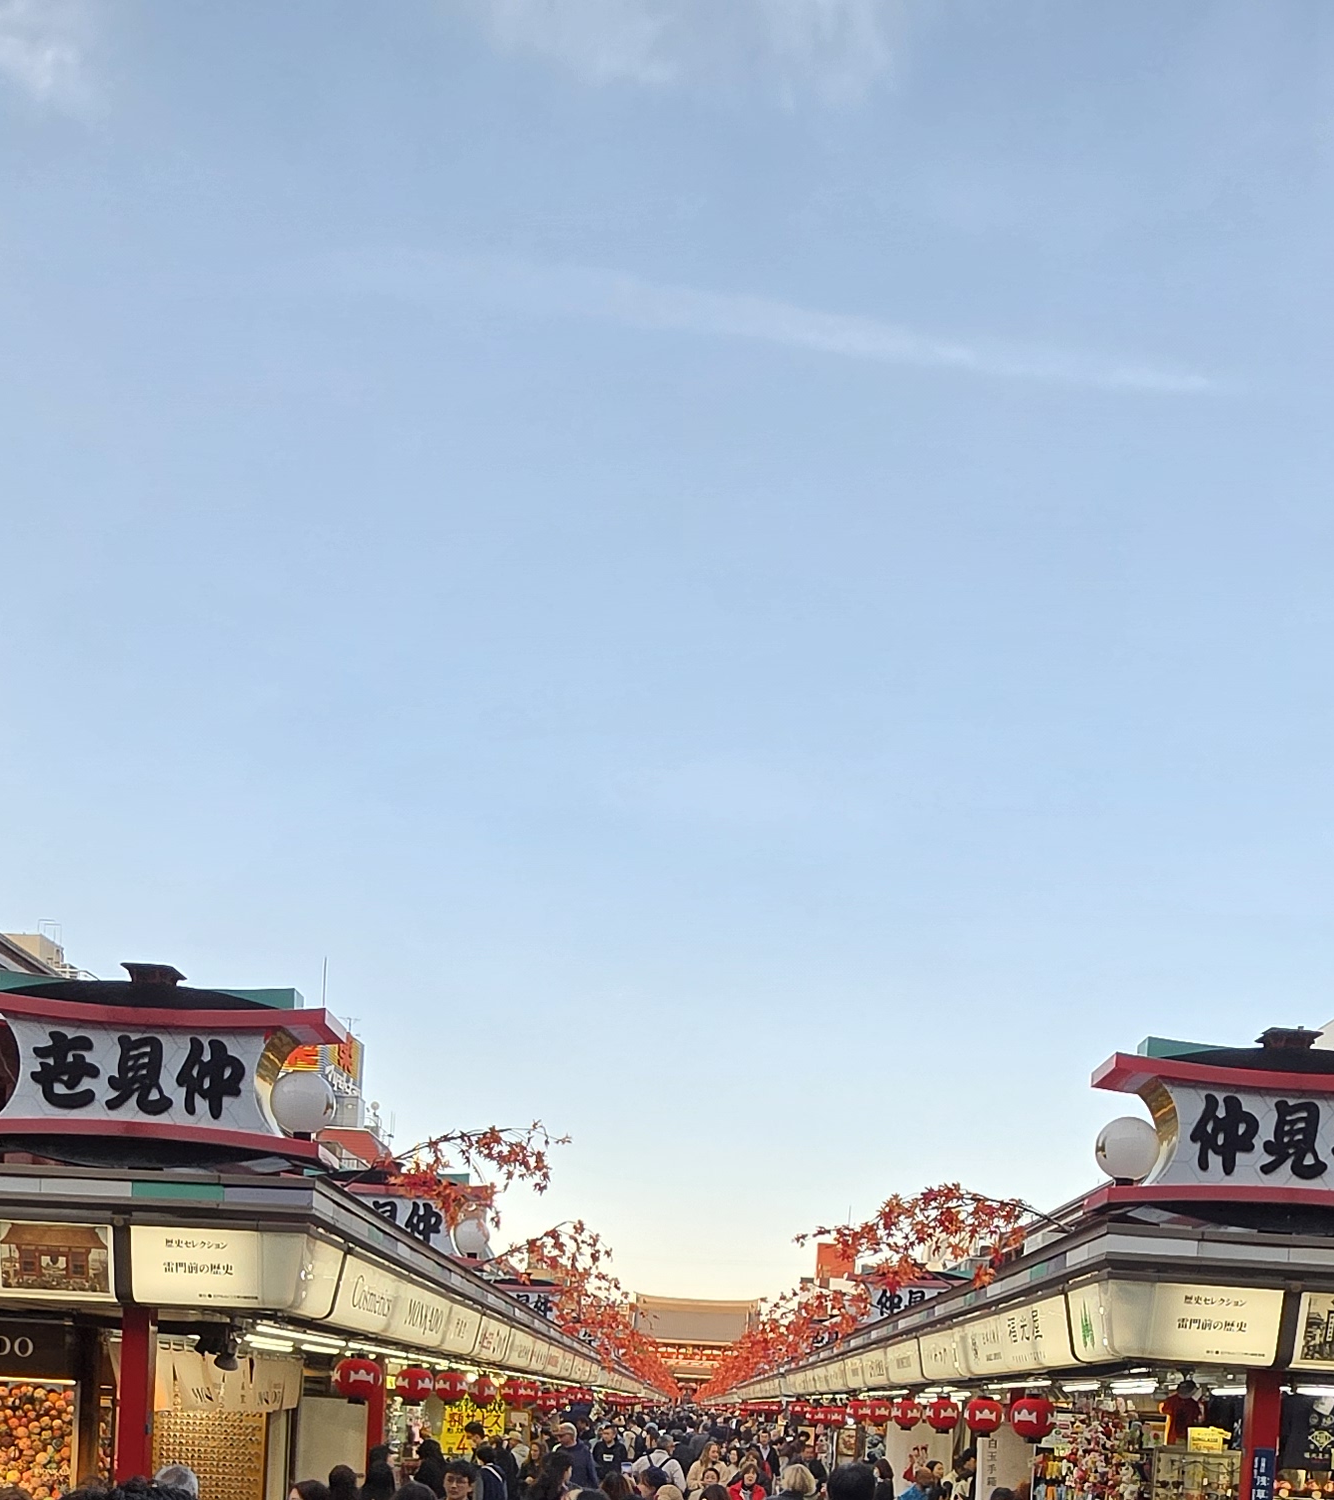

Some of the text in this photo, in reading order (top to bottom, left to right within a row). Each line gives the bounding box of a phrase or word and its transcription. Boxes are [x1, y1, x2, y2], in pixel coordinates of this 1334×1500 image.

[165, 1238, 228, 1250] 歴史セレクション
[162, 1261, 234, 1276] 雷門前の歴史
[1184, 1295, 1247, 1307] 歴史セレクション
[1177, 1317, 1247, 1333] 雷門前の歴史
